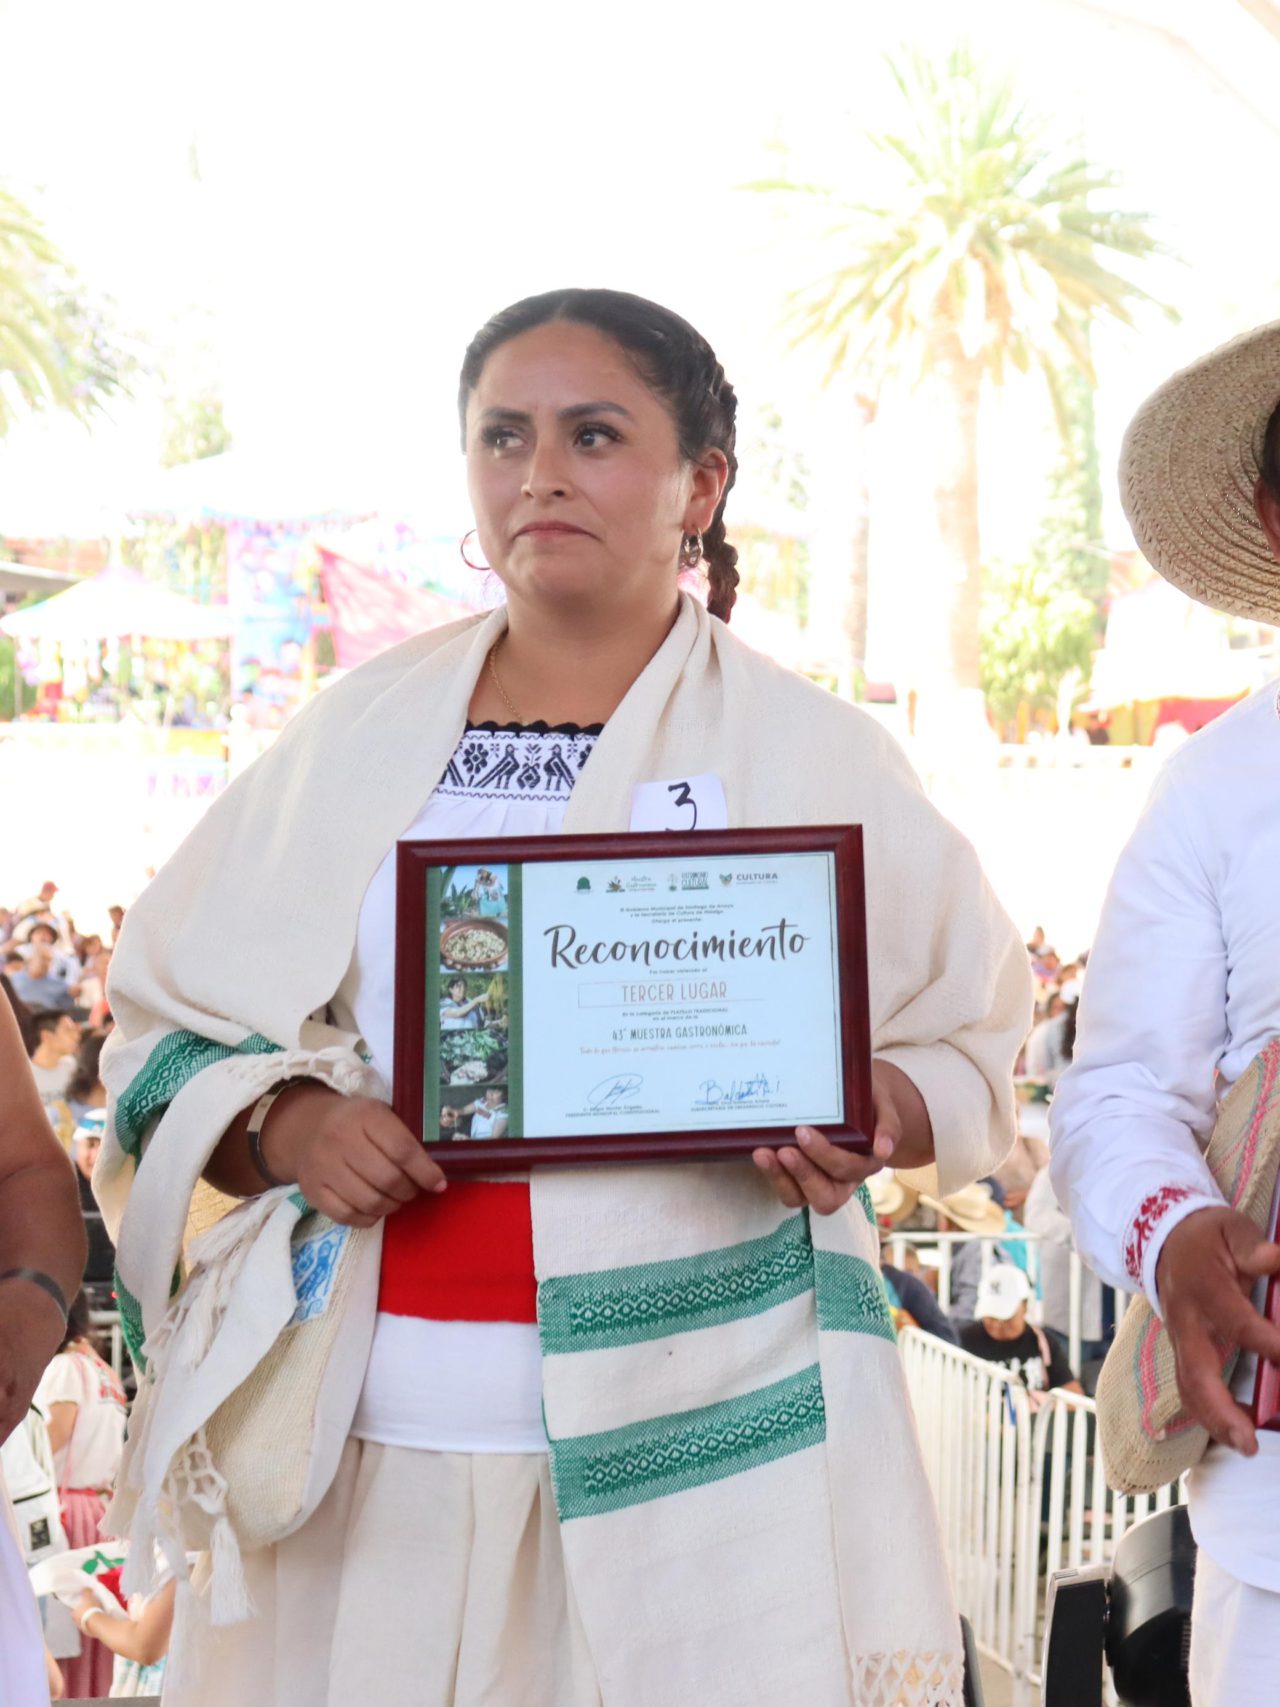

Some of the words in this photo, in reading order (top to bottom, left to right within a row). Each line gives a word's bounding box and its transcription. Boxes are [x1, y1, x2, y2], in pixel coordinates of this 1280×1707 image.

[665, 781, 697, 832] 3
[736, 872, 779, 882] CULTURA
[543, 917, 811, 969] Reconocimiento
[621, 982, 675, 1003] TERCER
[680, 979, 728, 1000] LUGAR
[629, 1026, 671, 1040] MUESTRA
[674, 1020, 747, 1038] GASTRONÓMICA
